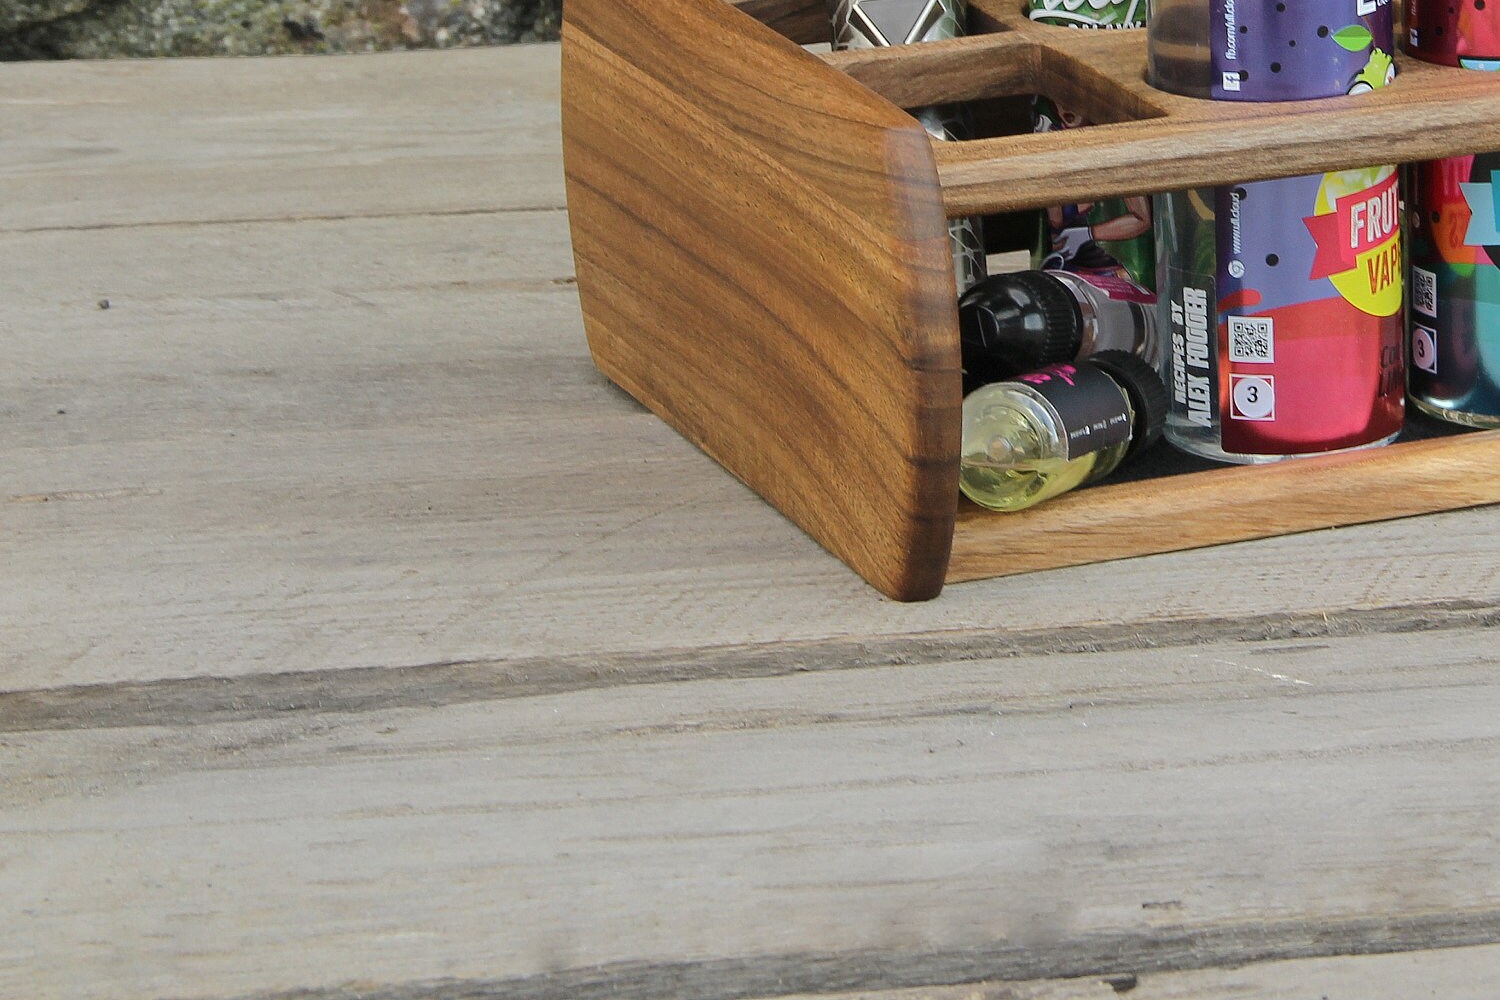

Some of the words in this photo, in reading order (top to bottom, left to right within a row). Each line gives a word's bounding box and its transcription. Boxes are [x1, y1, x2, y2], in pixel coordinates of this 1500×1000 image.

[1170, 300, 1184, 326] BY
[1183, 287, 1209, 369] FOGGER
[1172, 332, 1187, 405] RECIPES
[1417, 339, 1425, 358] 3
[1187, 373, 1212, 428] ALEX
[1247, 386, 1258, 403] 3
